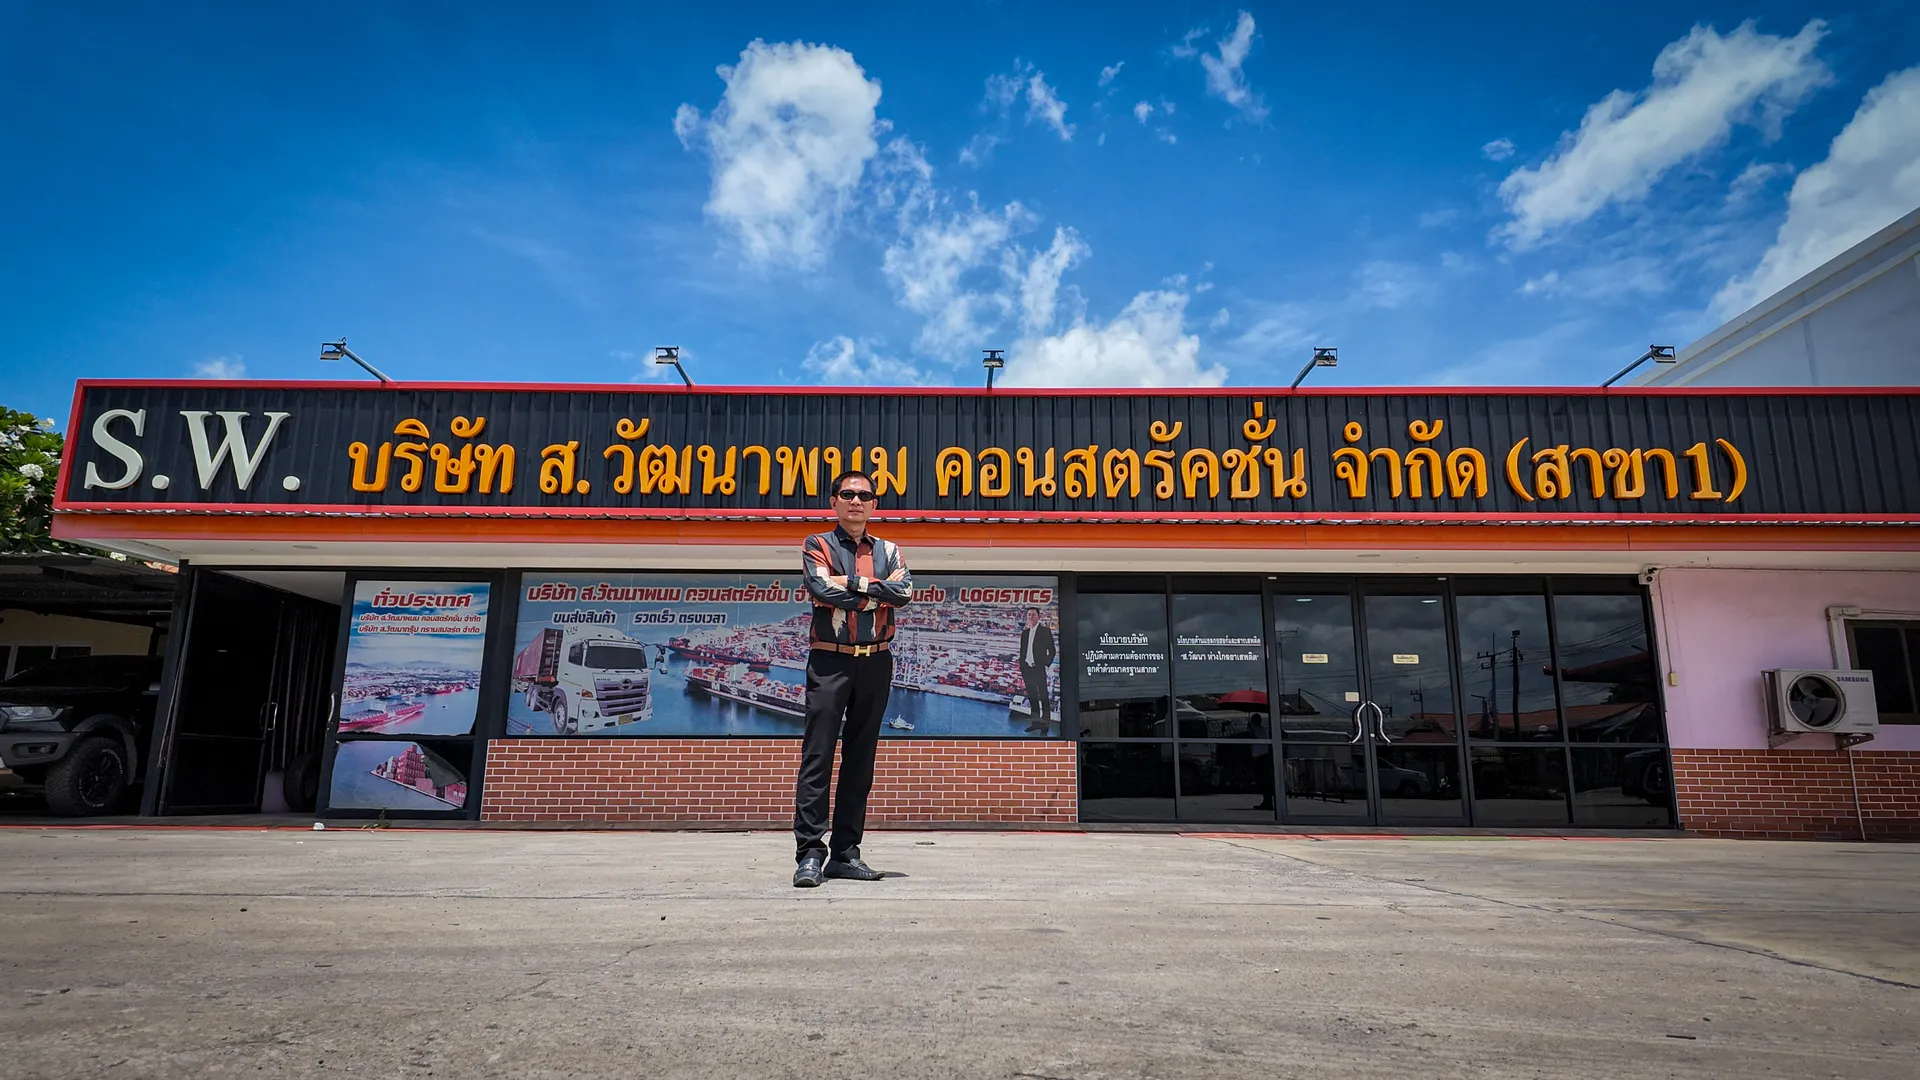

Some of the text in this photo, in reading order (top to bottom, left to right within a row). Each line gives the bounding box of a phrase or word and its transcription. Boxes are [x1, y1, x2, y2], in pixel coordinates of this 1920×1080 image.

[84, 408, 300, 491] S.W.
[348, 416, 516, 494] บริษัท
[935, 402, 1308, 499] คอนสตรัคชั่น
[1332, 419, 1488, 499] จำกัด
[373, 587, 472, 607] ทั่วประเทศ
[528, 583, 576, 601] บริษัท
[686, 580, 789, 602] คอนสตรัคชั่น
[912, 586, 945, 602] นส่ง
[960, 589, 1051, 603] LOGISTICS
[554, 609, 726, 624] ขนส่งสินค้า รวดเร็ว ตรงเวลา
[1100, 633, 1148, 645] นโยบายบริษัท
